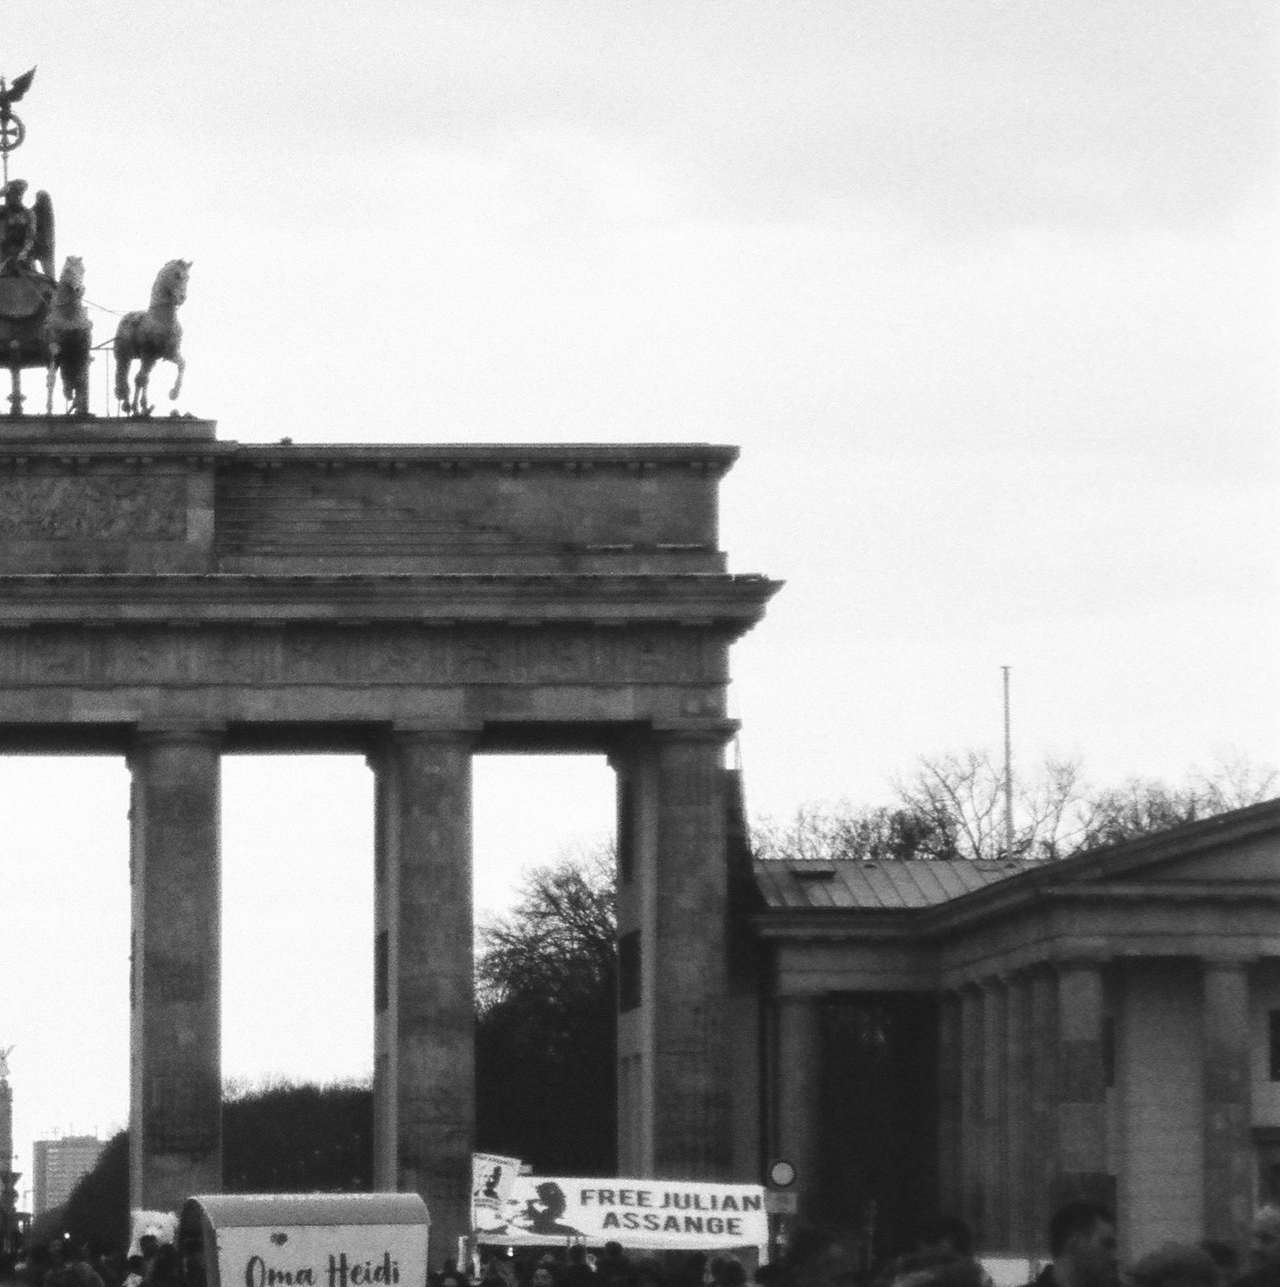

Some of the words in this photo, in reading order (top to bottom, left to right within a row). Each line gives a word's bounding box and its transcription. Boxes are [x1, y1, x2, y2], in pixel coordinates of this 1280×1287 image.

[580, 1188, 653, 1208] FREE
[659, 1192, 762, 1212] JULIAN
[602, 1211, 744, 1236] ASSANGE
